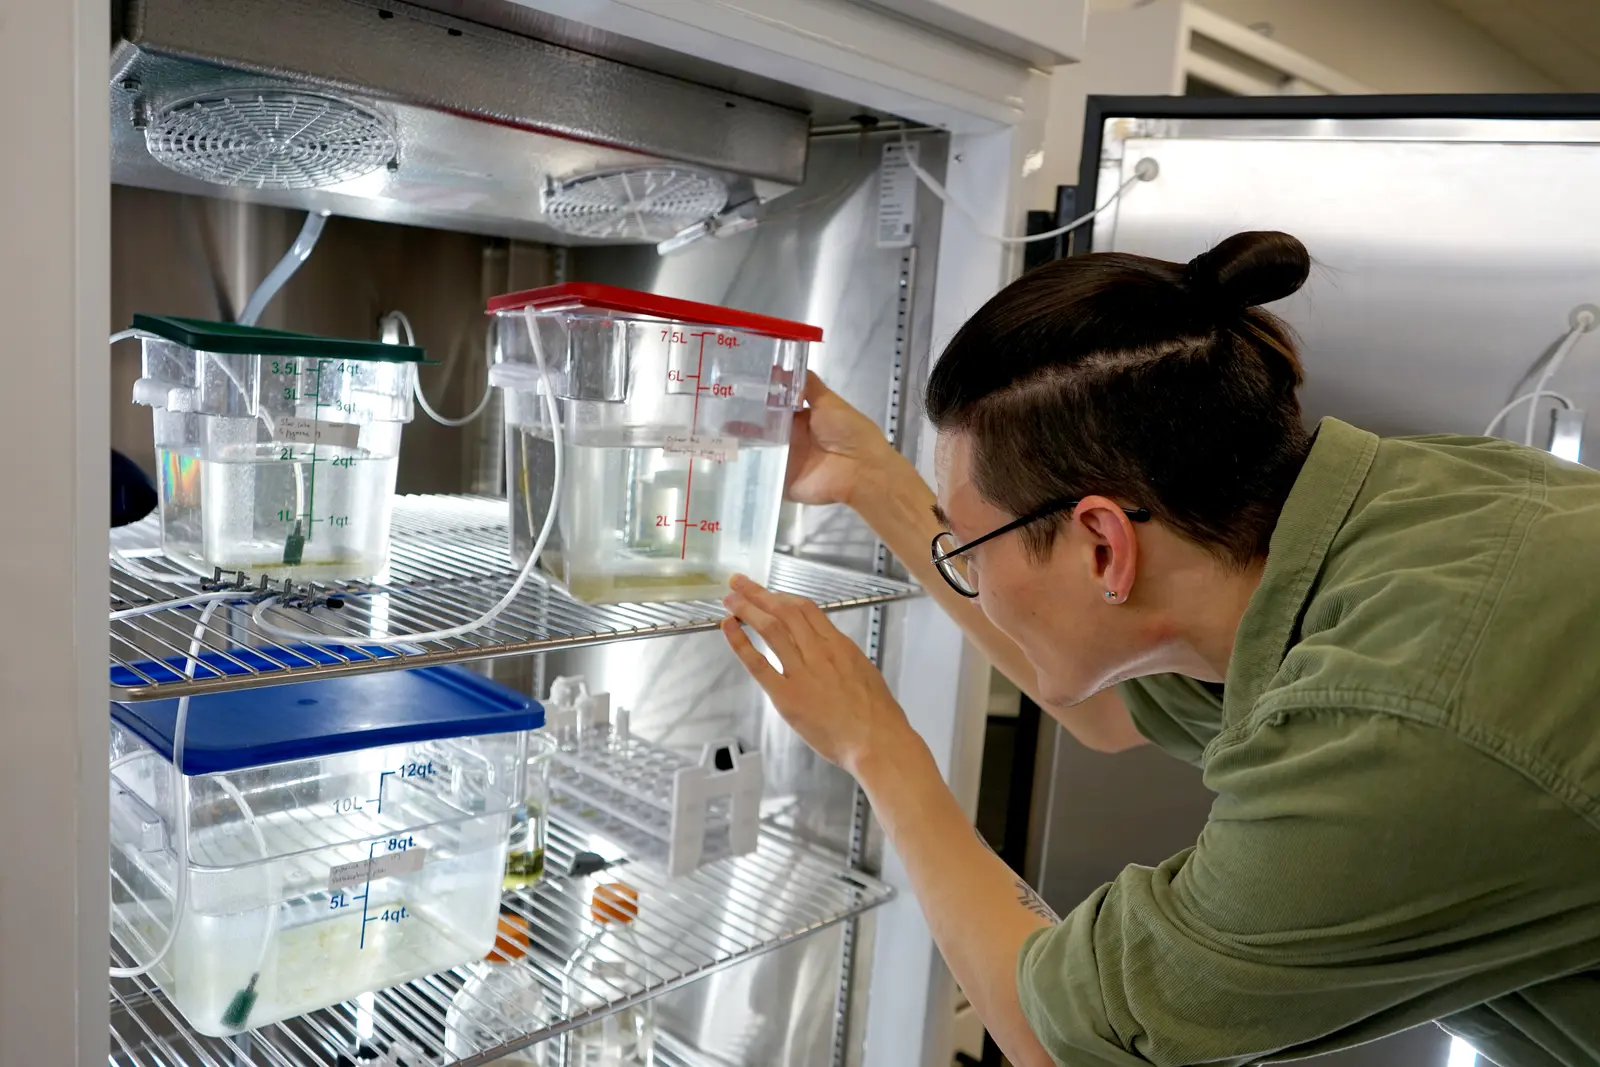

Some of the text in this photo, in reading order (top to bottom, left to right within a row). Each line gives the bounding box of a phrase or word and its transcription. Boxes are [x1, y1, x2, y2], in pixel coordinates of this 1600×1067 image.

[661, 331, 688, 344] 7.5L
[717, 333, 741, 348] 8qt.
[271, 361, 302, 375] 3.5L
[337, 362, 363, 377] 4qt.
[668, 370, 684, 382] 6L
[283, 388, 300, 400] 3L
[712, 383, 735, 398] 6qt.
[336, 400, 360, 415] 3qt.
[280, 448, 297, 460] 2L
[332, 455, 357, 469] 2qt.
[277, 510, 294, 521] 1L
[656, 515, 671, 527] 2L
[700, 519, 722, 534] 2qt.
[399, 762, 436, 779] 12qt.
[333, 797, 363, 813] 10L
[388, 836, 417, 851] 8qt.
[330, 894, 349, 909] 5L
[381, 906, 410, 923] 4qt.
